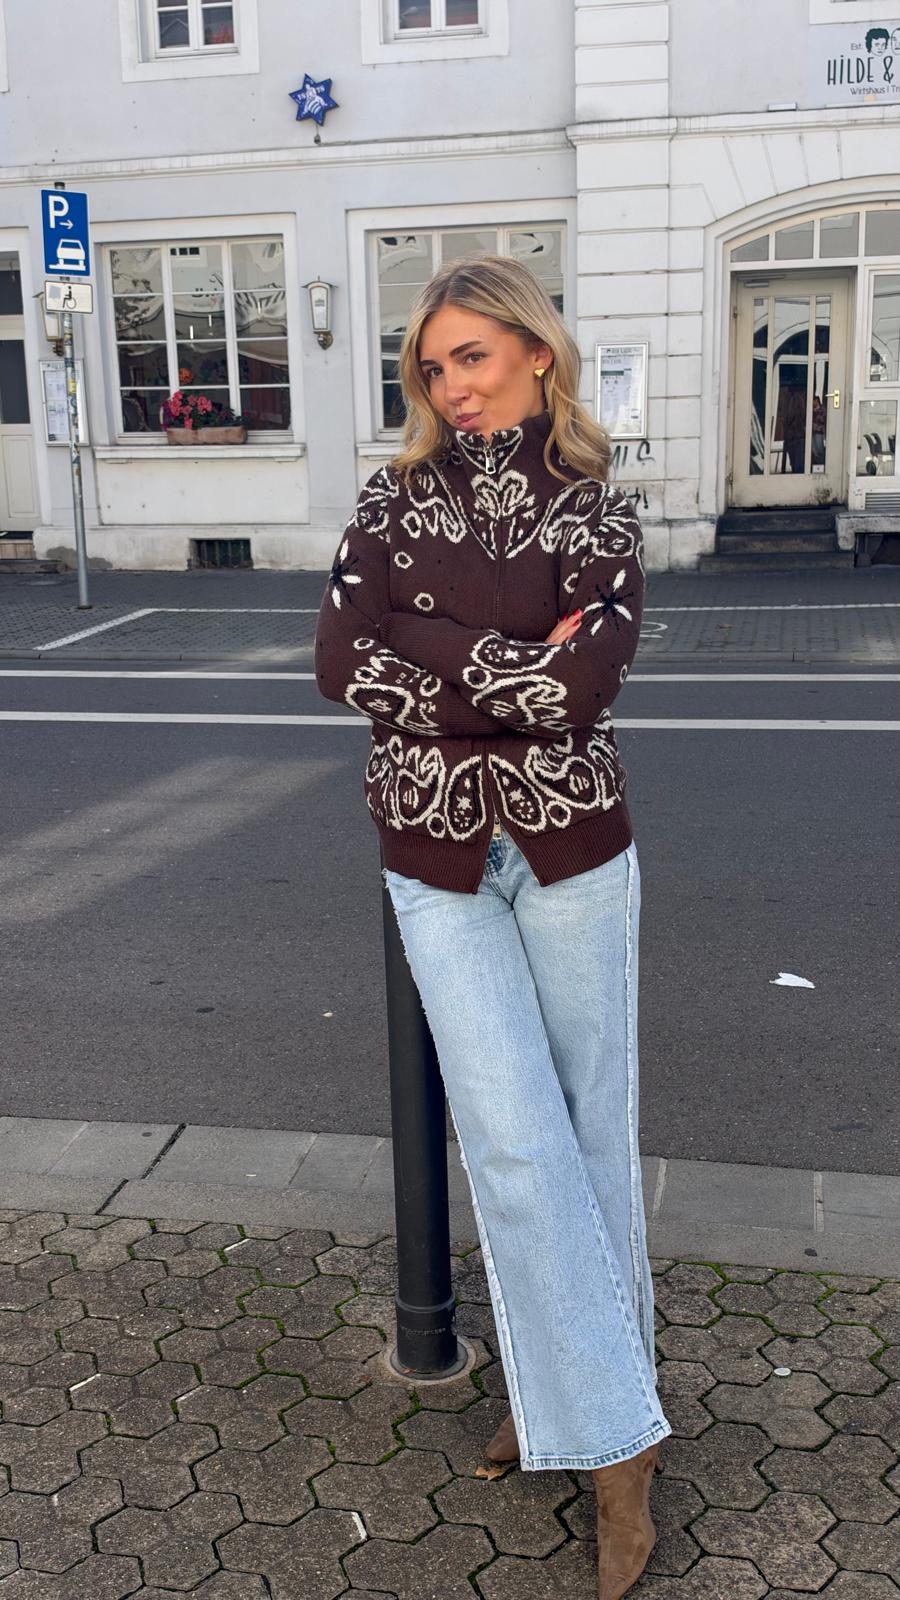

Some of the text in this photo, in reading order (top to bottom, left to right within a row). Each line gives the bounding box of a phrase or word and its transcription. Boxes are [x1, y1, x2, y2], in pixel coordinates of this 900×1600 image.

[883, 55, 894, 84] &
[850, 86, 886, 95] Wirtshaus
[48, 195, 69, 229] P
